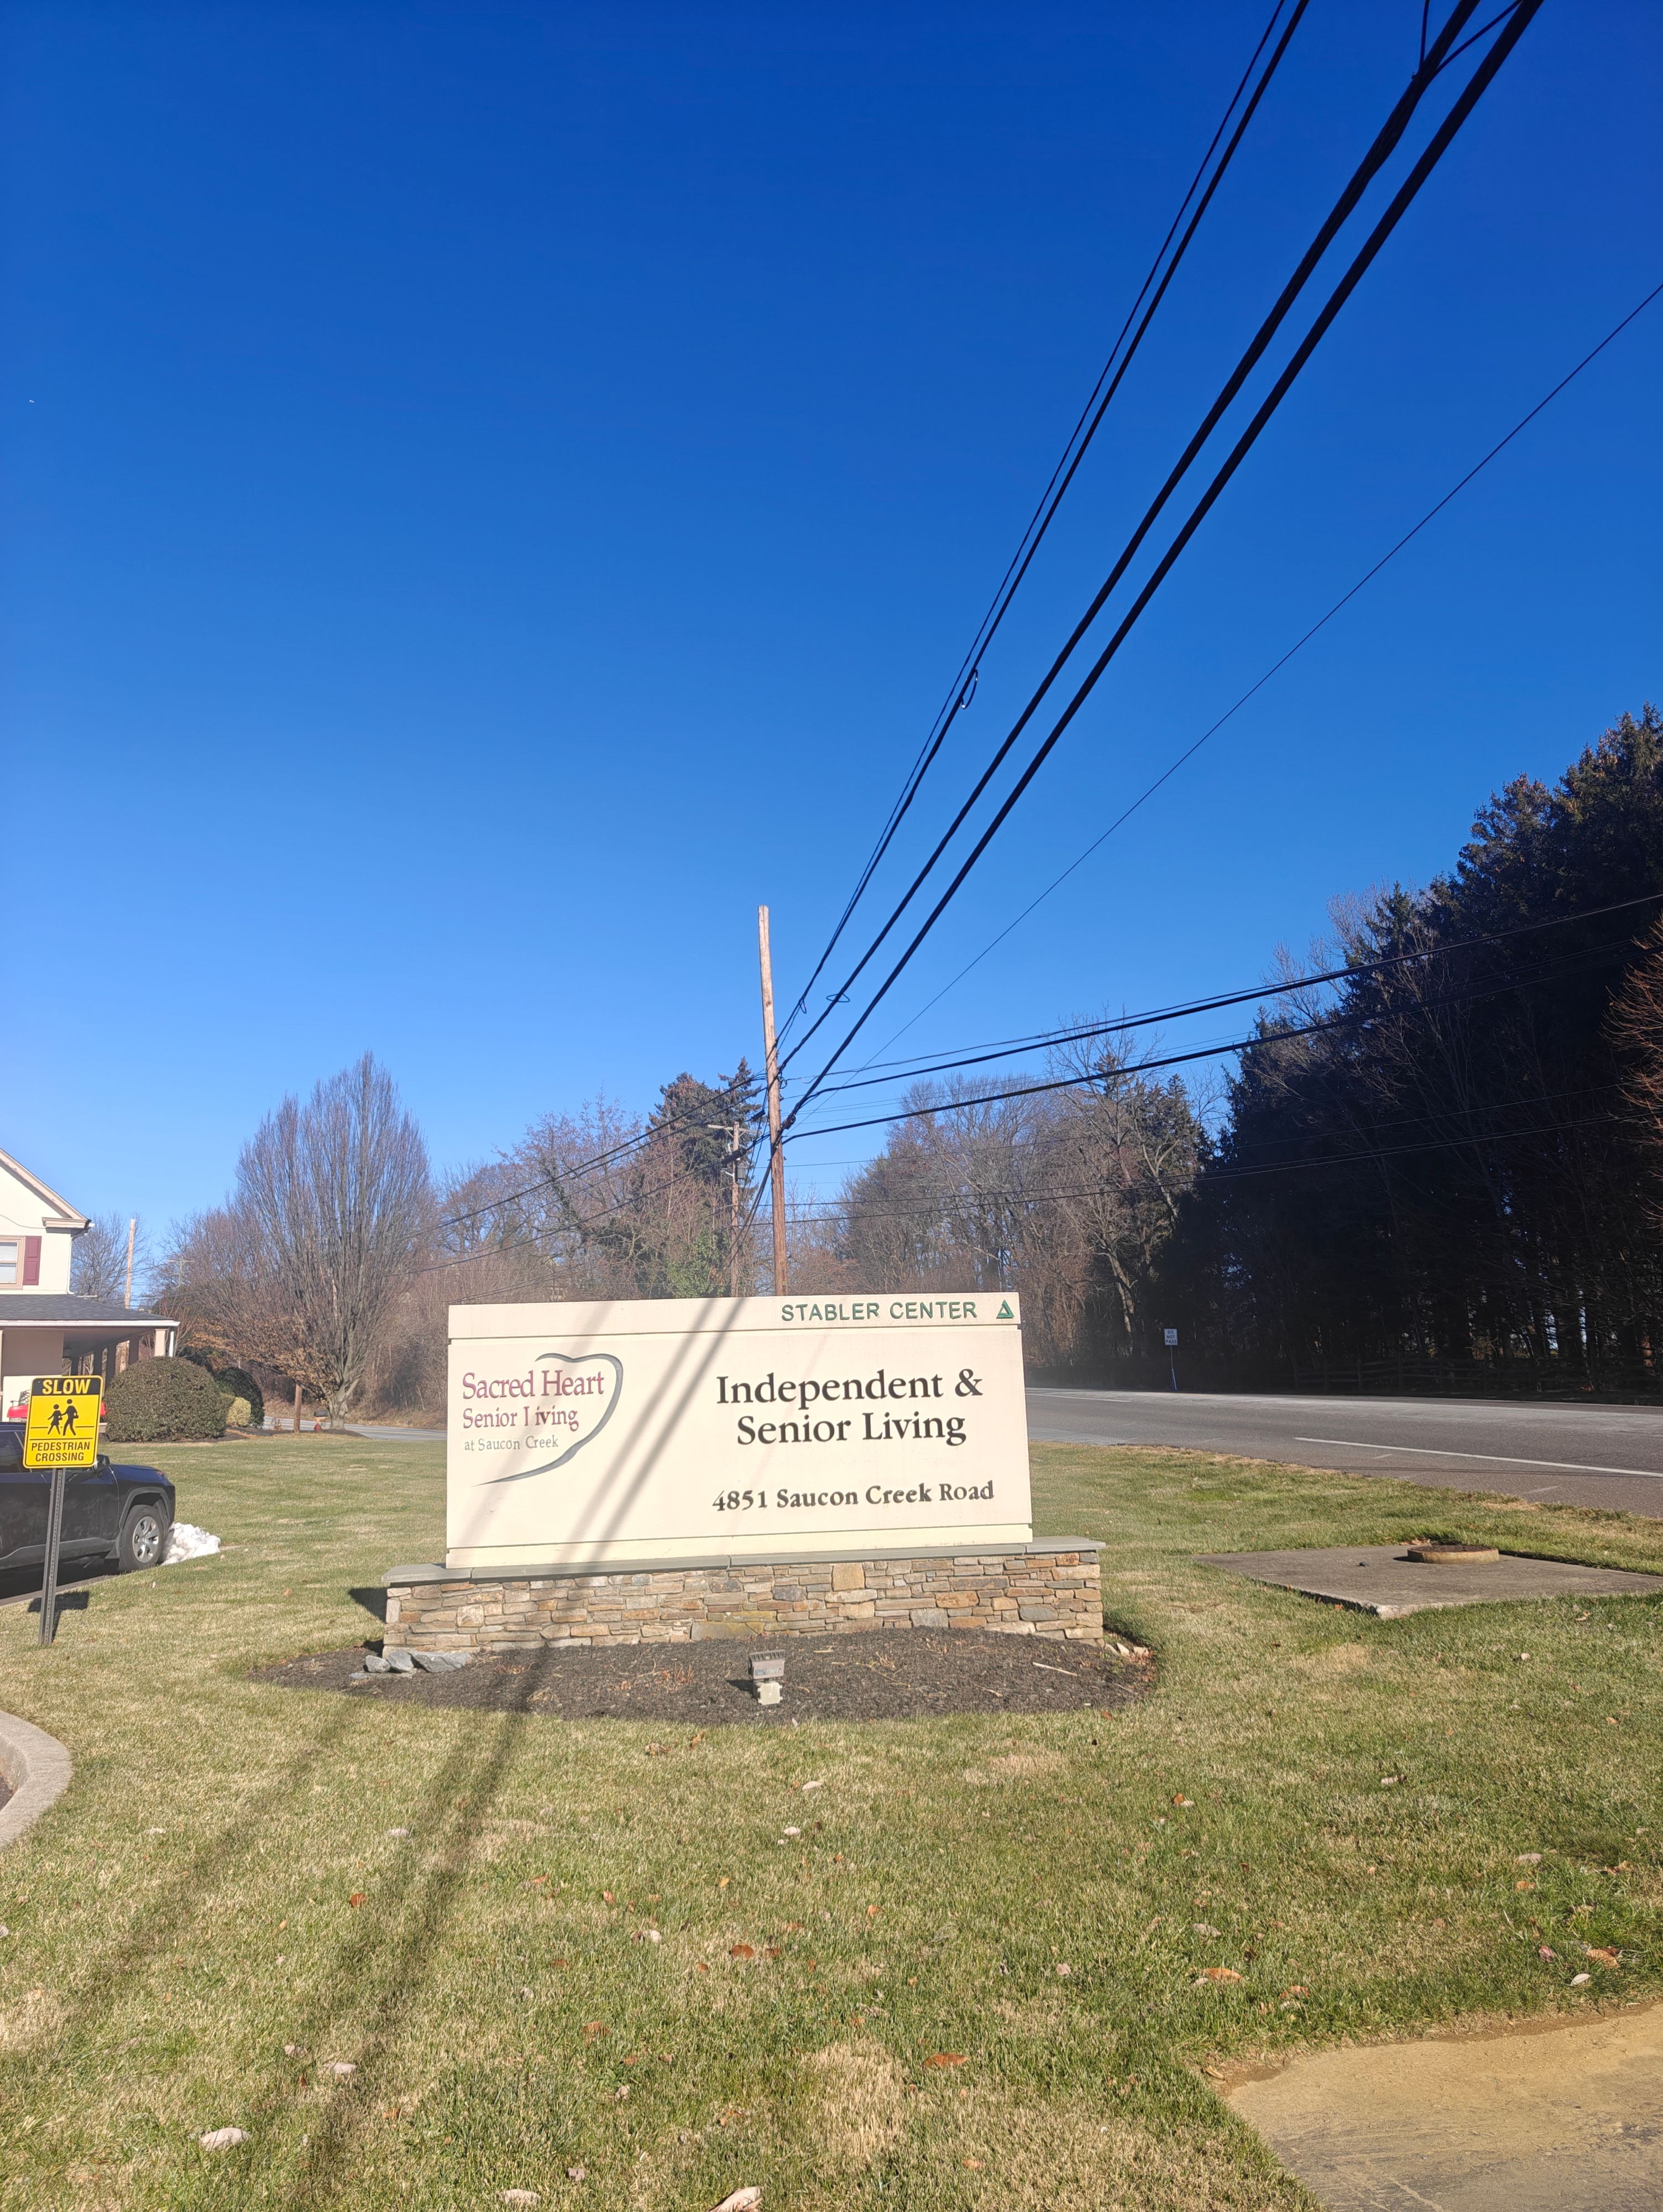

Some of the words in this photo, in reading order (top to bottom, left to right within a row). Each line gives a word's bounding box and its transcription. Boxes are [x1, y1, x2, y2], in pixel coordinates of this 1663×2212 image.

[781, 1302, 880, 1322] STABLER
[890, 1301, 977, 1319] CENTER
[42, 1379, 91, 1394] SLOW
[463, 1370, 535, 1399] Sacred
[541, 1370, 604, 1396] Heart
[717, 1369, 943, 1410] Independent
[955, 1368, 983, 1397] &
[463, 1407, 517, 1428] Senior
[737, 1414, 851, 1446] Senior
[862, 1411, 966, 1446] Living
[32, 1442, 90, 1452] PEDESTRIAN
[464, 1440, 474, 1451] at
[478, 1438, 520, 1451] Saucon
[525, 1435, 559, 1449] Creek
[35, 1453, 84, 1462] CROSSING
[712, 1490, 767, 1511] 4851
[776, 1489, 859, 1508] Saucon
[865, 1483, 932, 1504] Creek
[939, 1480, 995, 1501] Road
